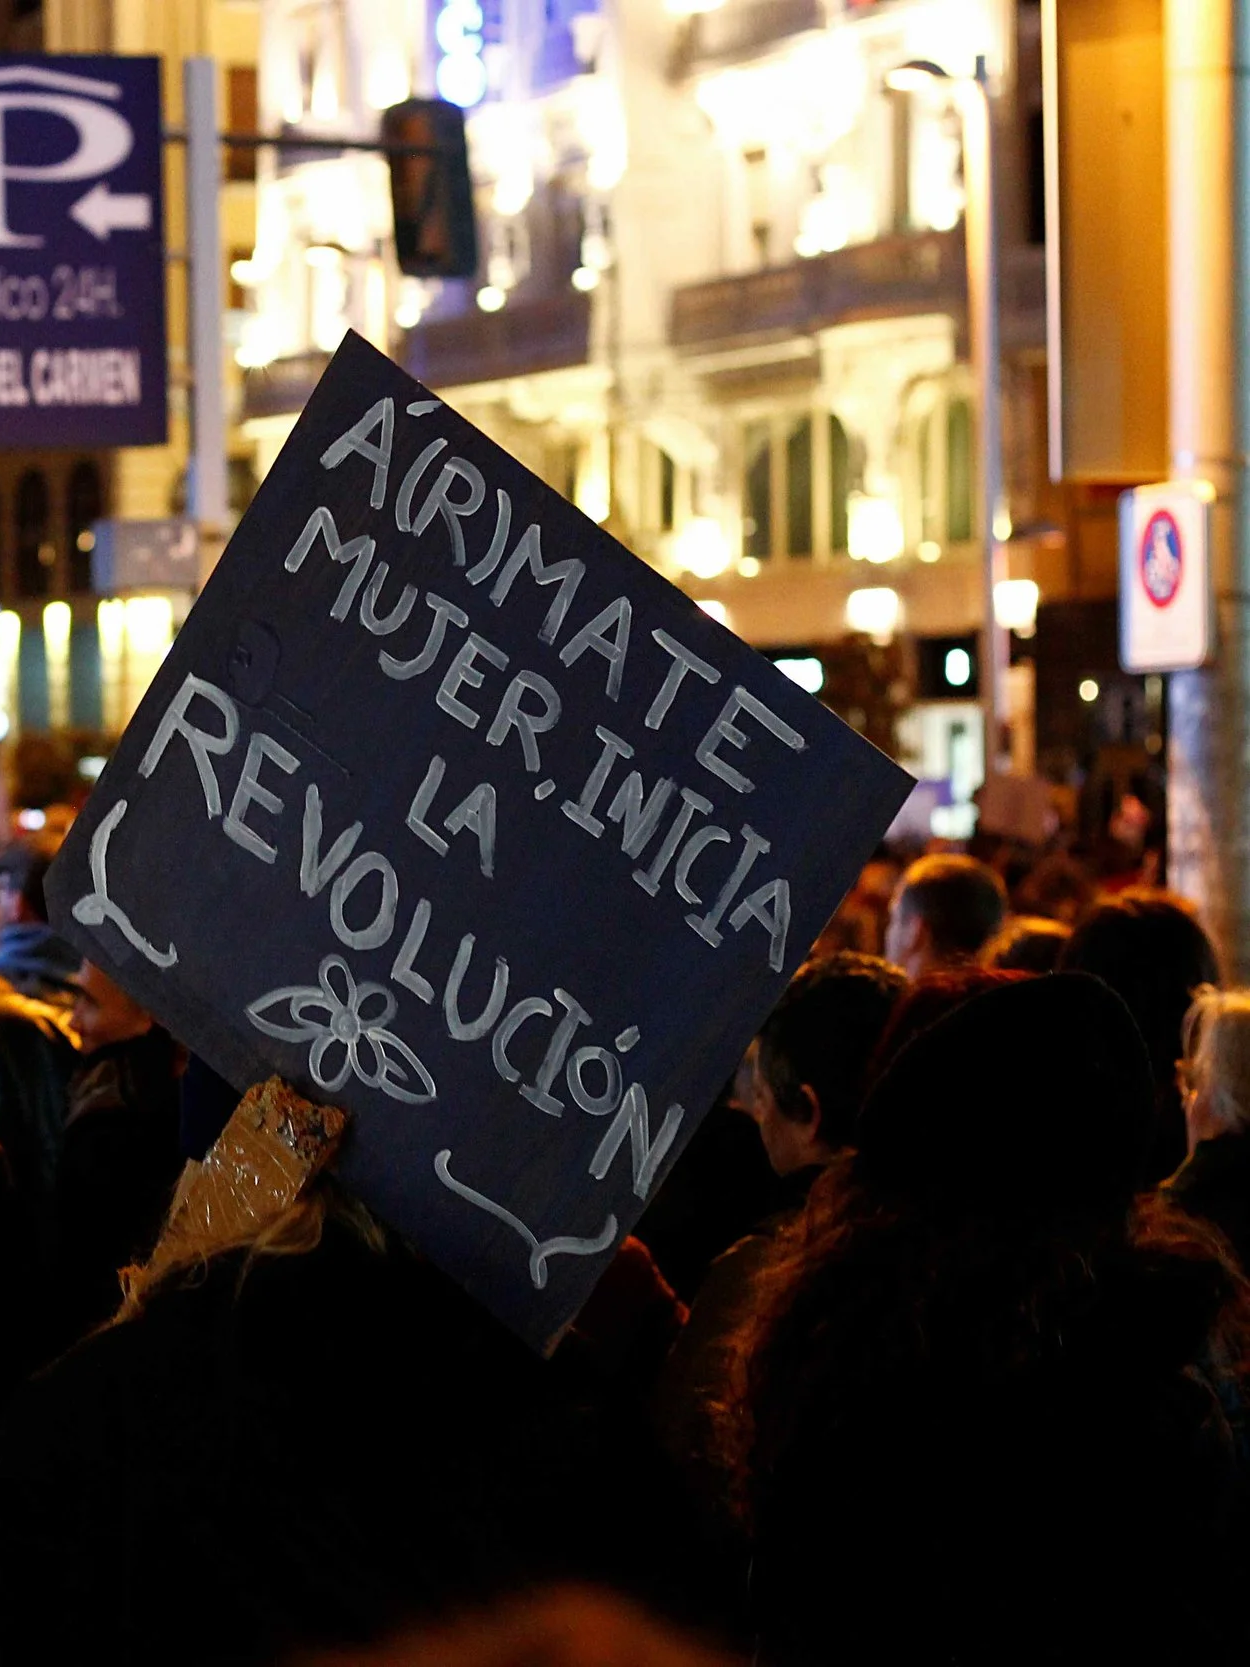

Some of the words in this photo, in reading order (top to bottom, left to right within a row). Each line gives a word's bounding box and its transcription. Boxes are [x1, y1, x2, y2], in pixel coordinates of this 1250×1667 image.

[31, 348, 141, 406] CARMEN
[320, 397, 806, 793] Á(R)MATE
[138, 672, 685, 1198] REVOLUCIÓN
[405, 755, 496, 879] LA
[560, 724, 791, 973] INICIA
